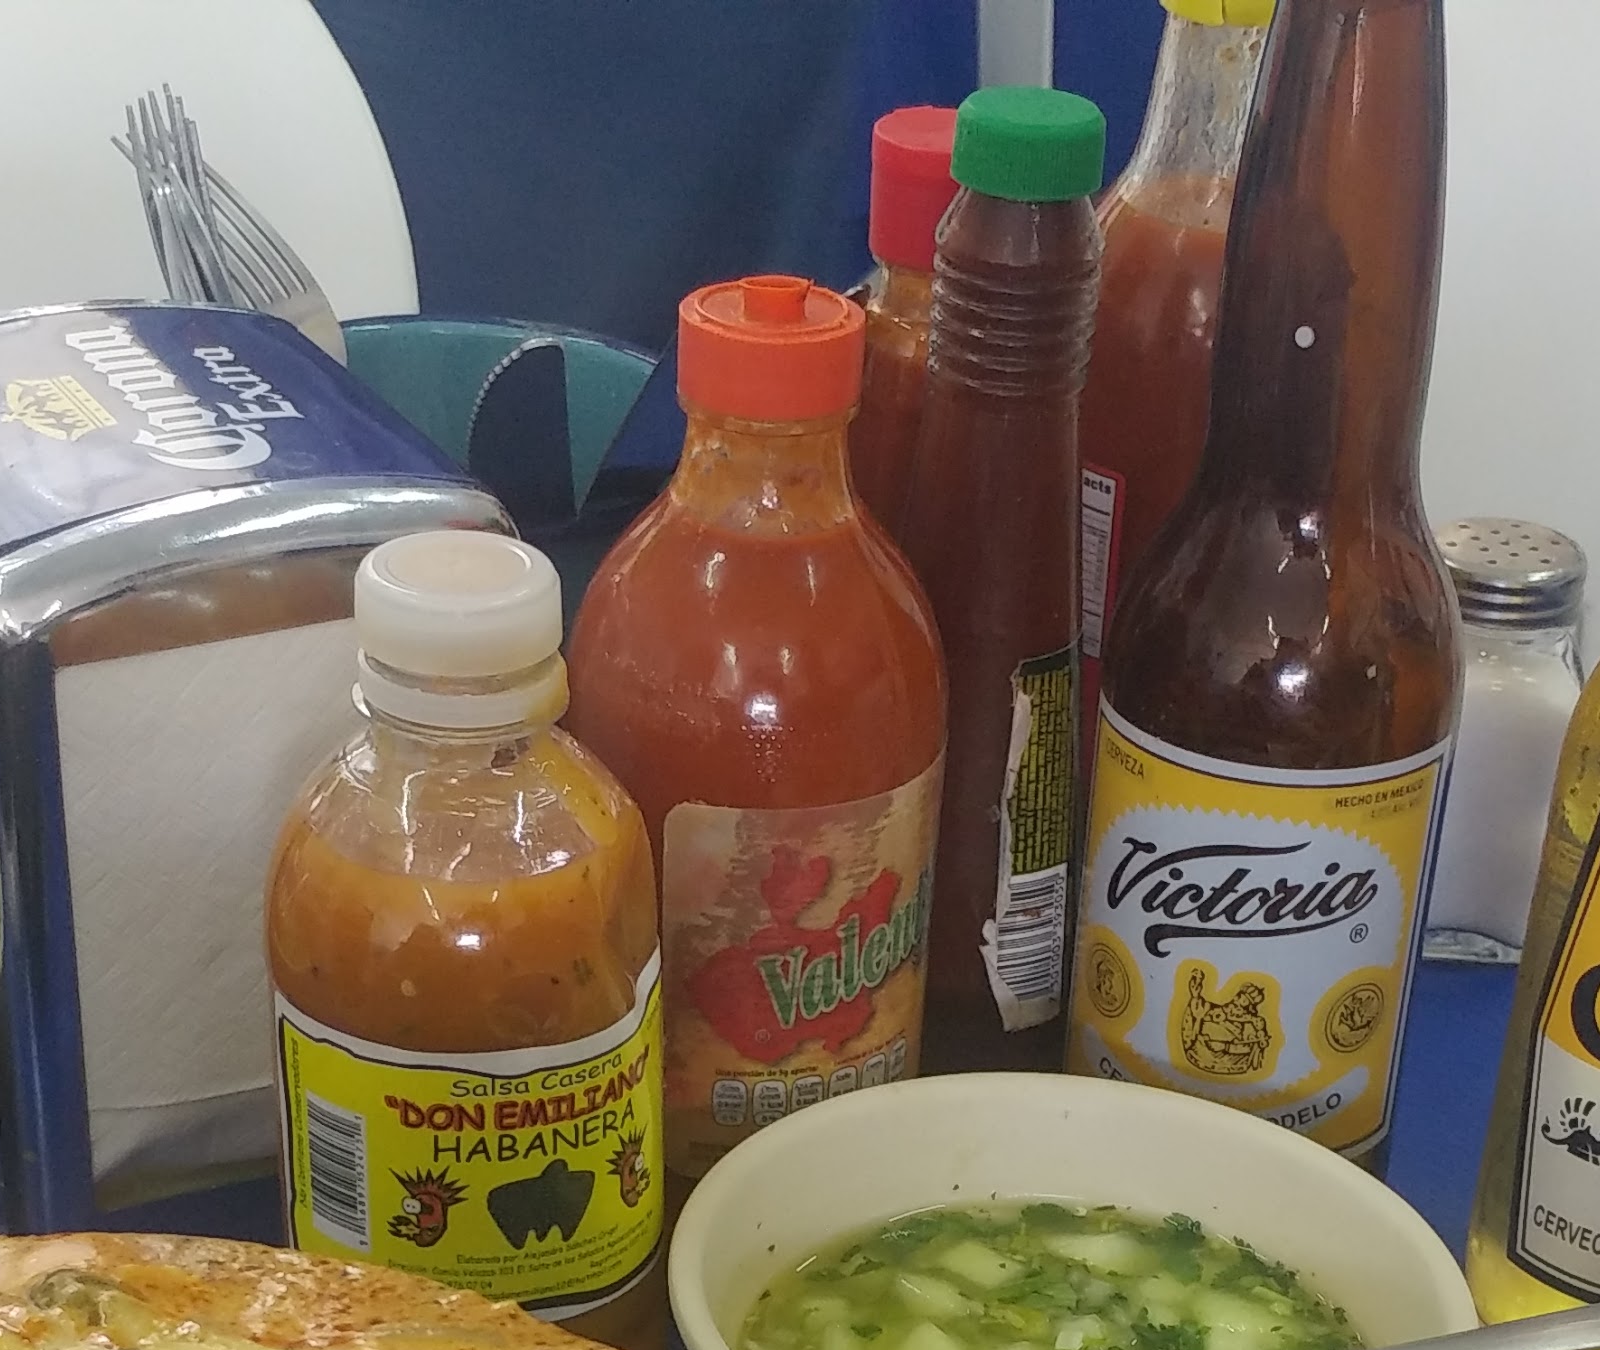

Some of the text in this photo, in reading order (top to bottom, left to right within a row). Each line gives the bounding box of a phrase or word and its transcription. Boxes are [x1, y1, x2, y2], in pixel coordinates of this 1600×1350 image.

[65, 324, 272, 471] Corona
[192, 345, 305, 420] Extra
[1083, 475, 1113, 495] acts
[1106, 736, 1145, 780] CERVEZA
[1335, 793, 1373, 809] HECHO
[1374, 791, 1389, 803] EN
[1389, 778, 1424, 799] MEXICO
[1106, 836, 1379, 958] Victoria
[450, 1052, 622, 1098] Salsa Casera
[433, 1097, 635, 1163] HABANERA
